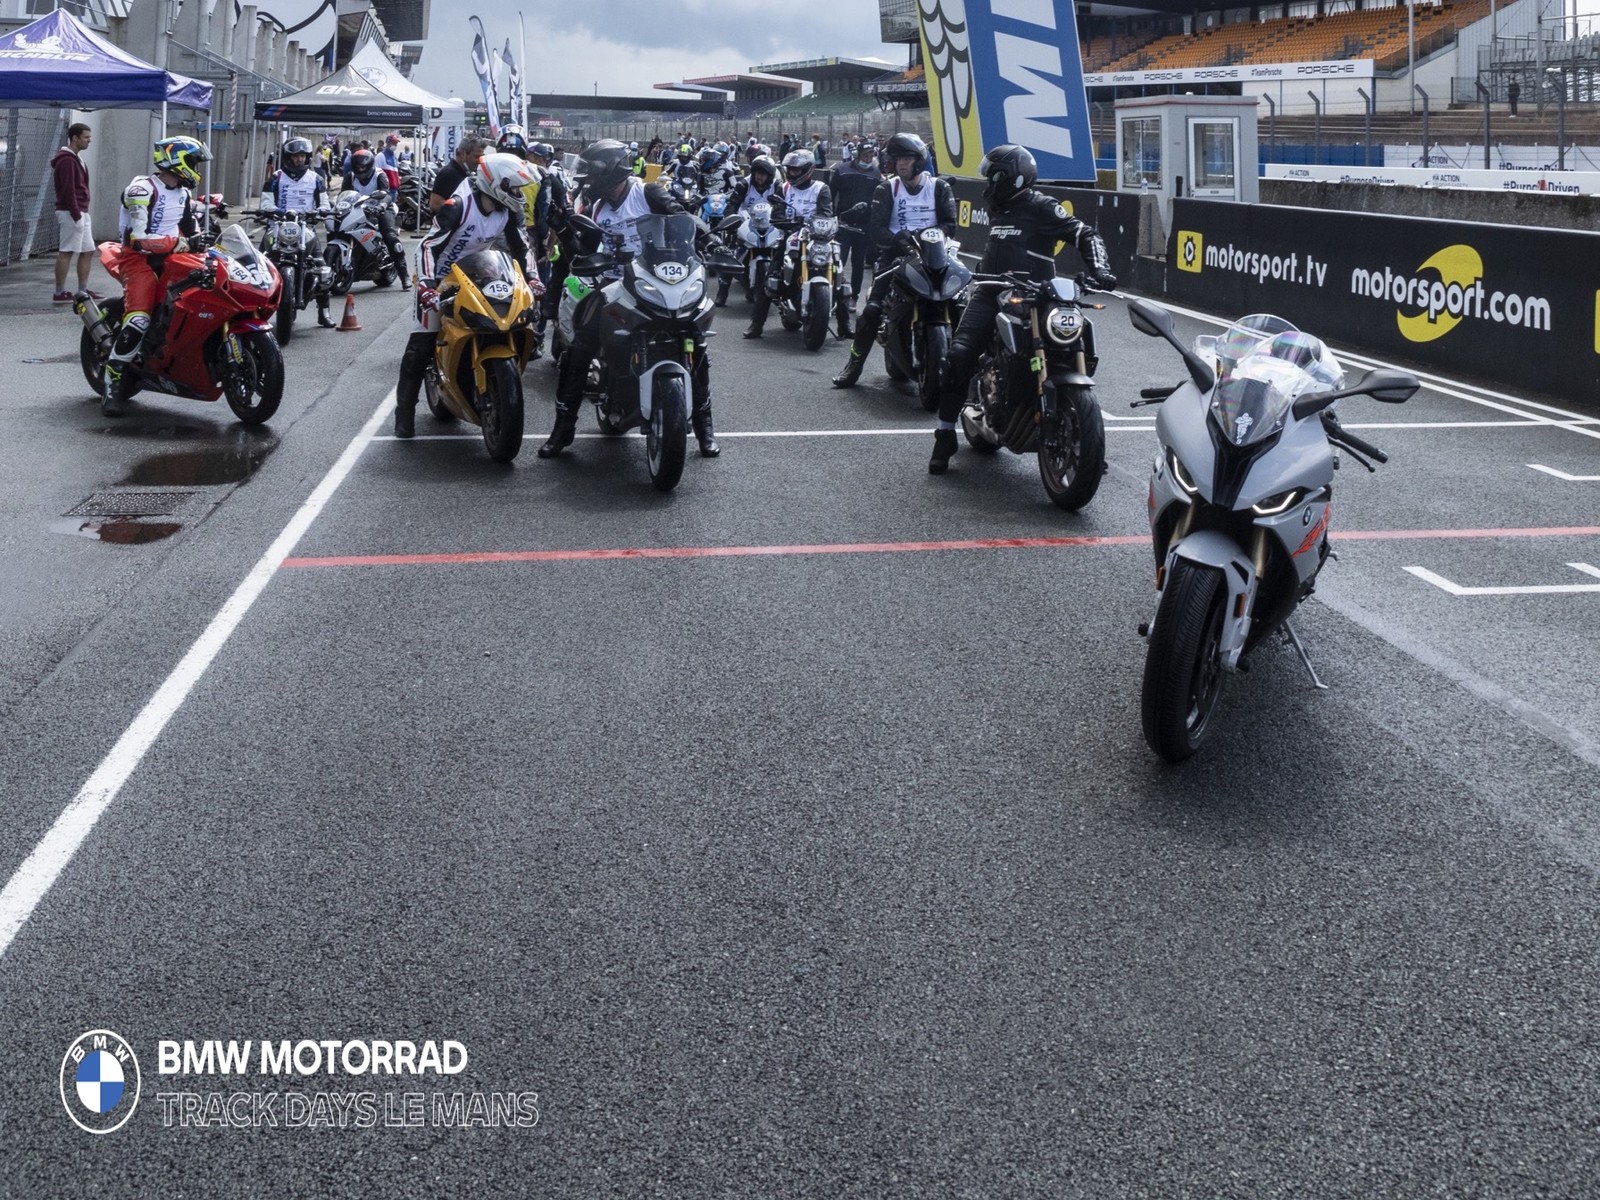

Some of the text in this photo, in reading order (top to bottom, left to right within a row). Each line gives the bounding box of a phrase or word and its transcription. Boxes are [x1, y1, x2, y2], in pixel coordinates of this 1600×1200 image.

[0, 52, 91, 61] ICHELIN
[1194, 69, 1239, 79] PORSCHE
[1251, 68, 1282, 77] #TeamPorsche
[1297, 64, 1355, 75] PORSCHE
[1144, 72, 1183, 81] PORSCHE
[316, 85, 371, 96] BMC
[1440, 174, 1461, 182] ACTION
[925, 231, 940, 239] 131
[1205, 242, 1328, 288] motorsport.tv
[232, 266, 248, 281] 164
[661, 265, 683, 276] 134
[489, 284, 509, 293] 156
[1351, 266, 1552, 331] motorsport.com
[1060, 315, 1075, 327] 20
